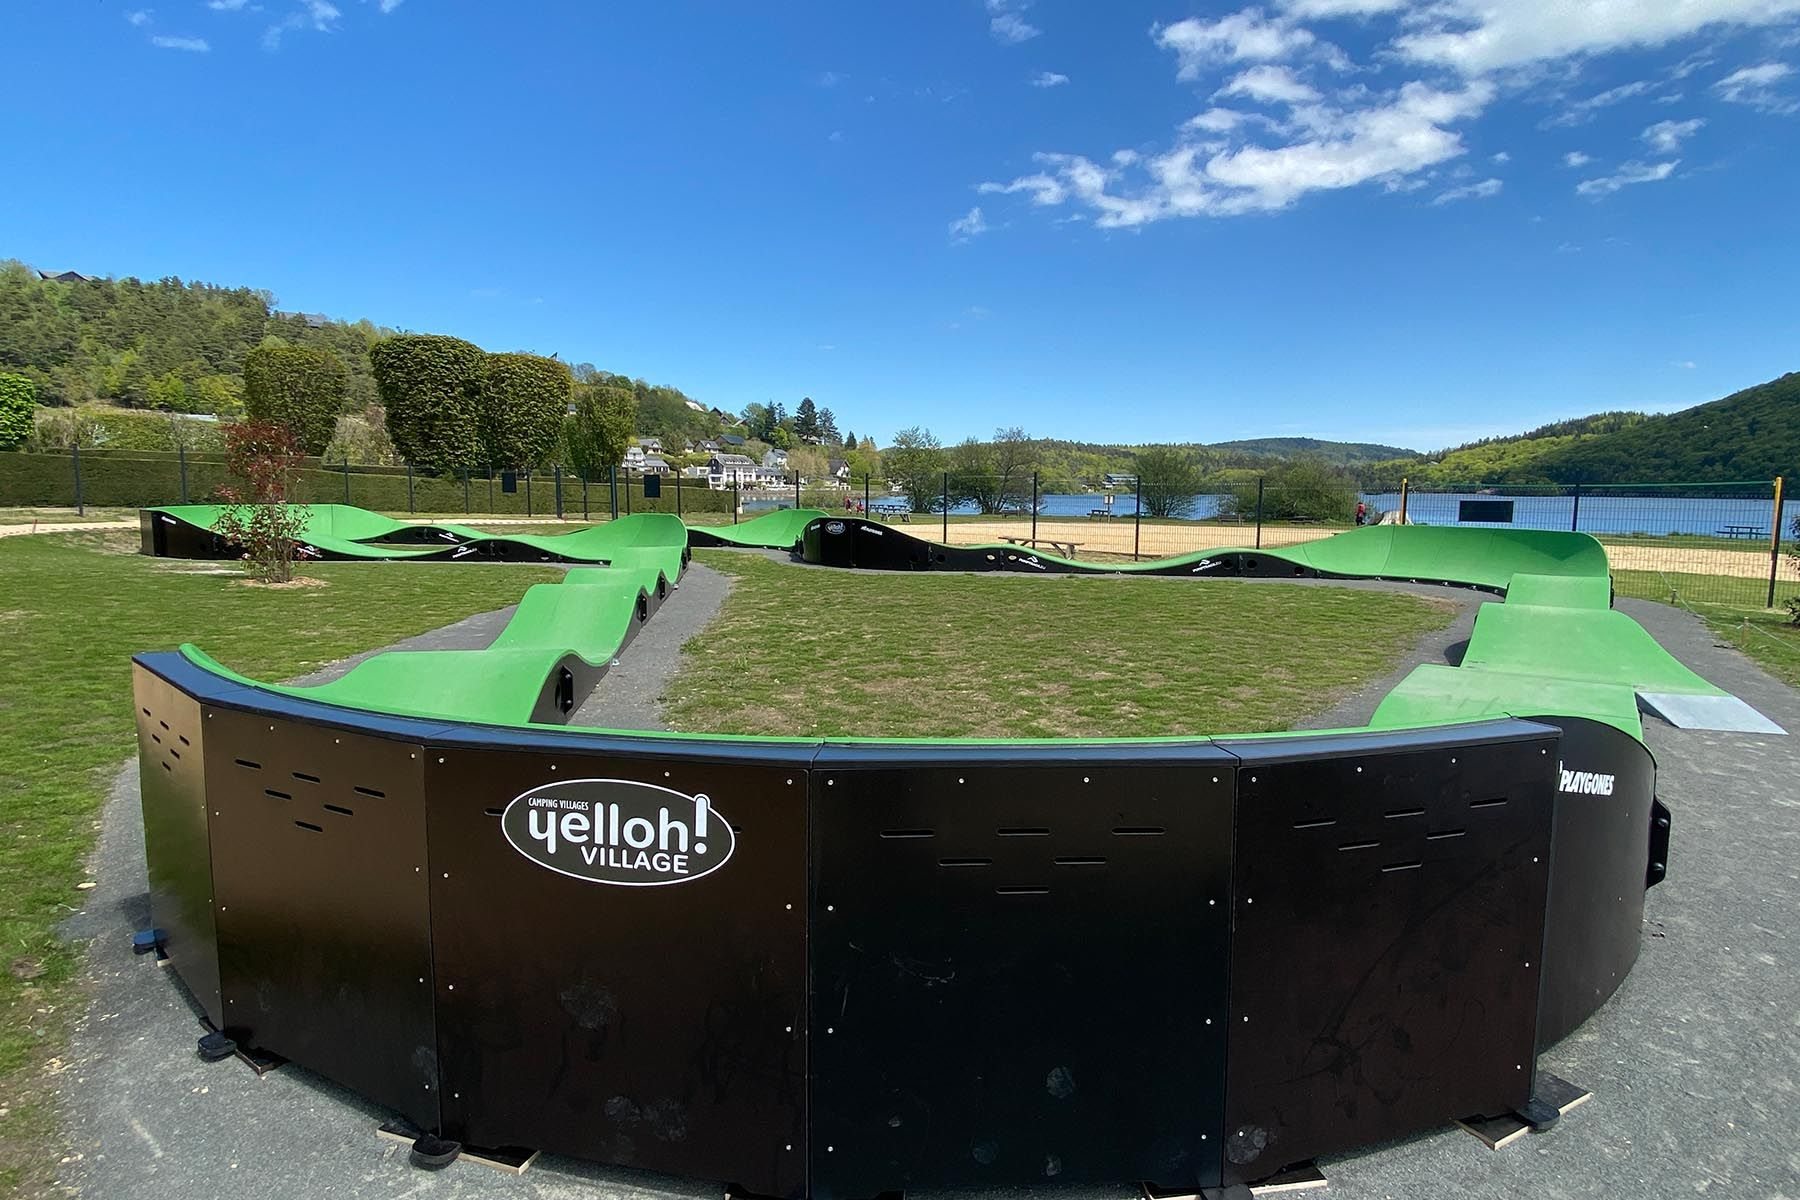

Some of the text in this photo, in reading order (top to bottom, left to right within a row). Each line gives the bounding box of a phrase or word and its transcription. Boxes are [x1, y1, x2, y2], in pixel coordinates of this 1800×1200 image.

[1559, 769, 1615, 796] PLAYGONES
[528, 797, 589, 811] CAMPING VILLAGES
[528, 797, 708, 854] yelloh!
[580, 845, 689, 874] VILLAGE
